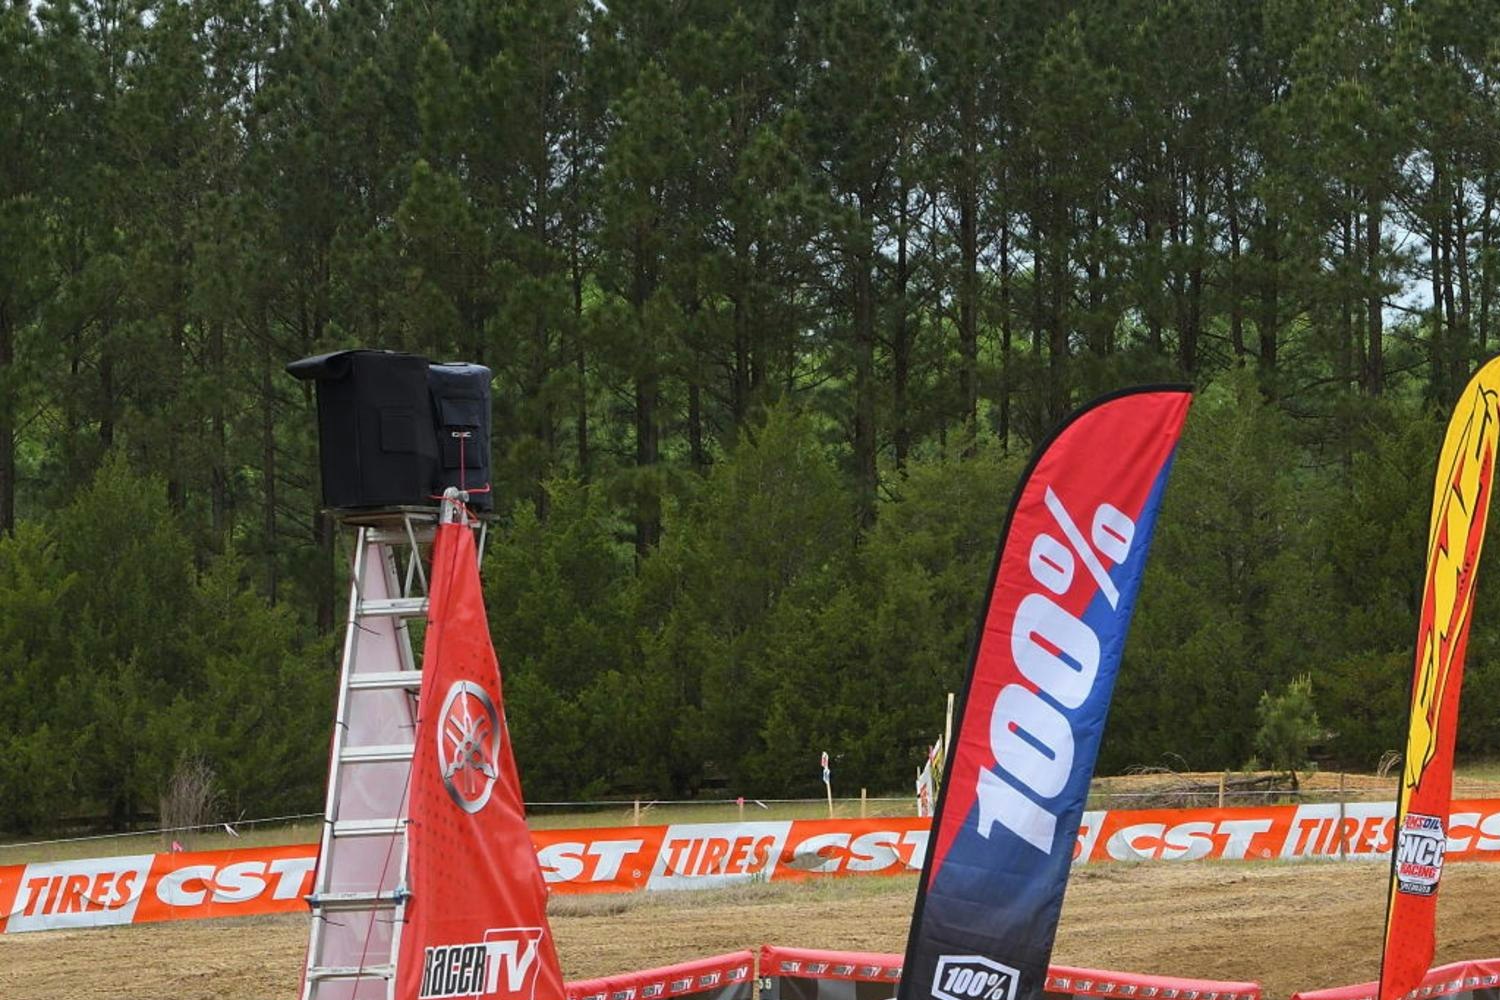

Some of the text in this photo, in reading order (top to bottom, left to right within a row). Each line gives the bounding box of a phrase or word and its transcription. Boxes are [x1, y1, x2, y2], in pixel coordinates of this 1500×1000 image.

[976, 485, 1136, 855] 100%
[538, 839, 642, 883] ST
[655, 835, 776, 876] TIRES
[1106, 819, 1274, 860] CST
[23, 858, 318, 917] TIRES CST
[943, 967, 1006, 1000] 100%
